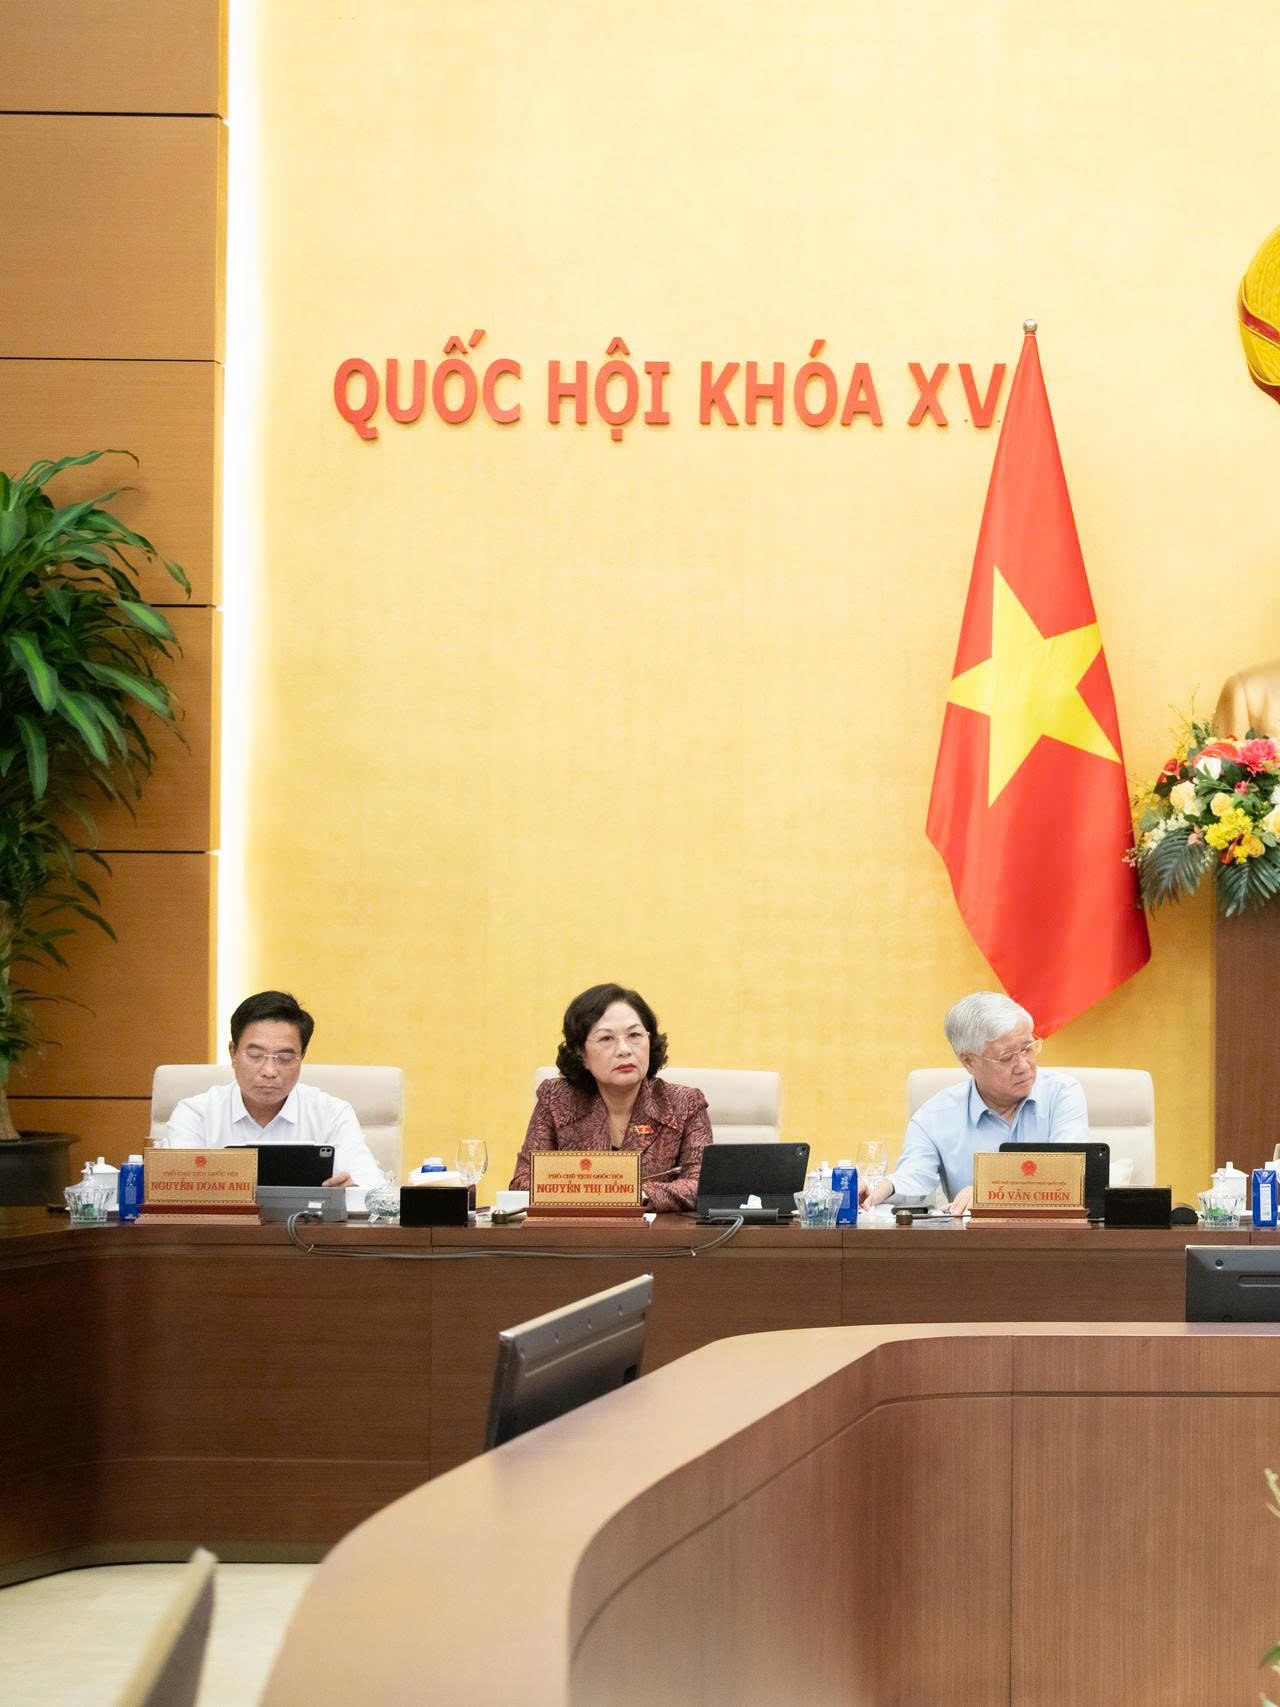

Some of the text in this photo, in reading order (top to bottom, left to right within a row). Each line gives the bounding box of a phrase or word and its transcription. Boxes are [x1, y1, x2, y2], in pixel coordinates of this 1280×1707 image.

[334, 330, 1007, 442] QUỐC HỘI KHÓA XV
[228, 1181, 250, 1190] ANH
[583, 1184, 601, 1195] THỊ
[1033, 1187, 1071, 1201] CHIẾN
